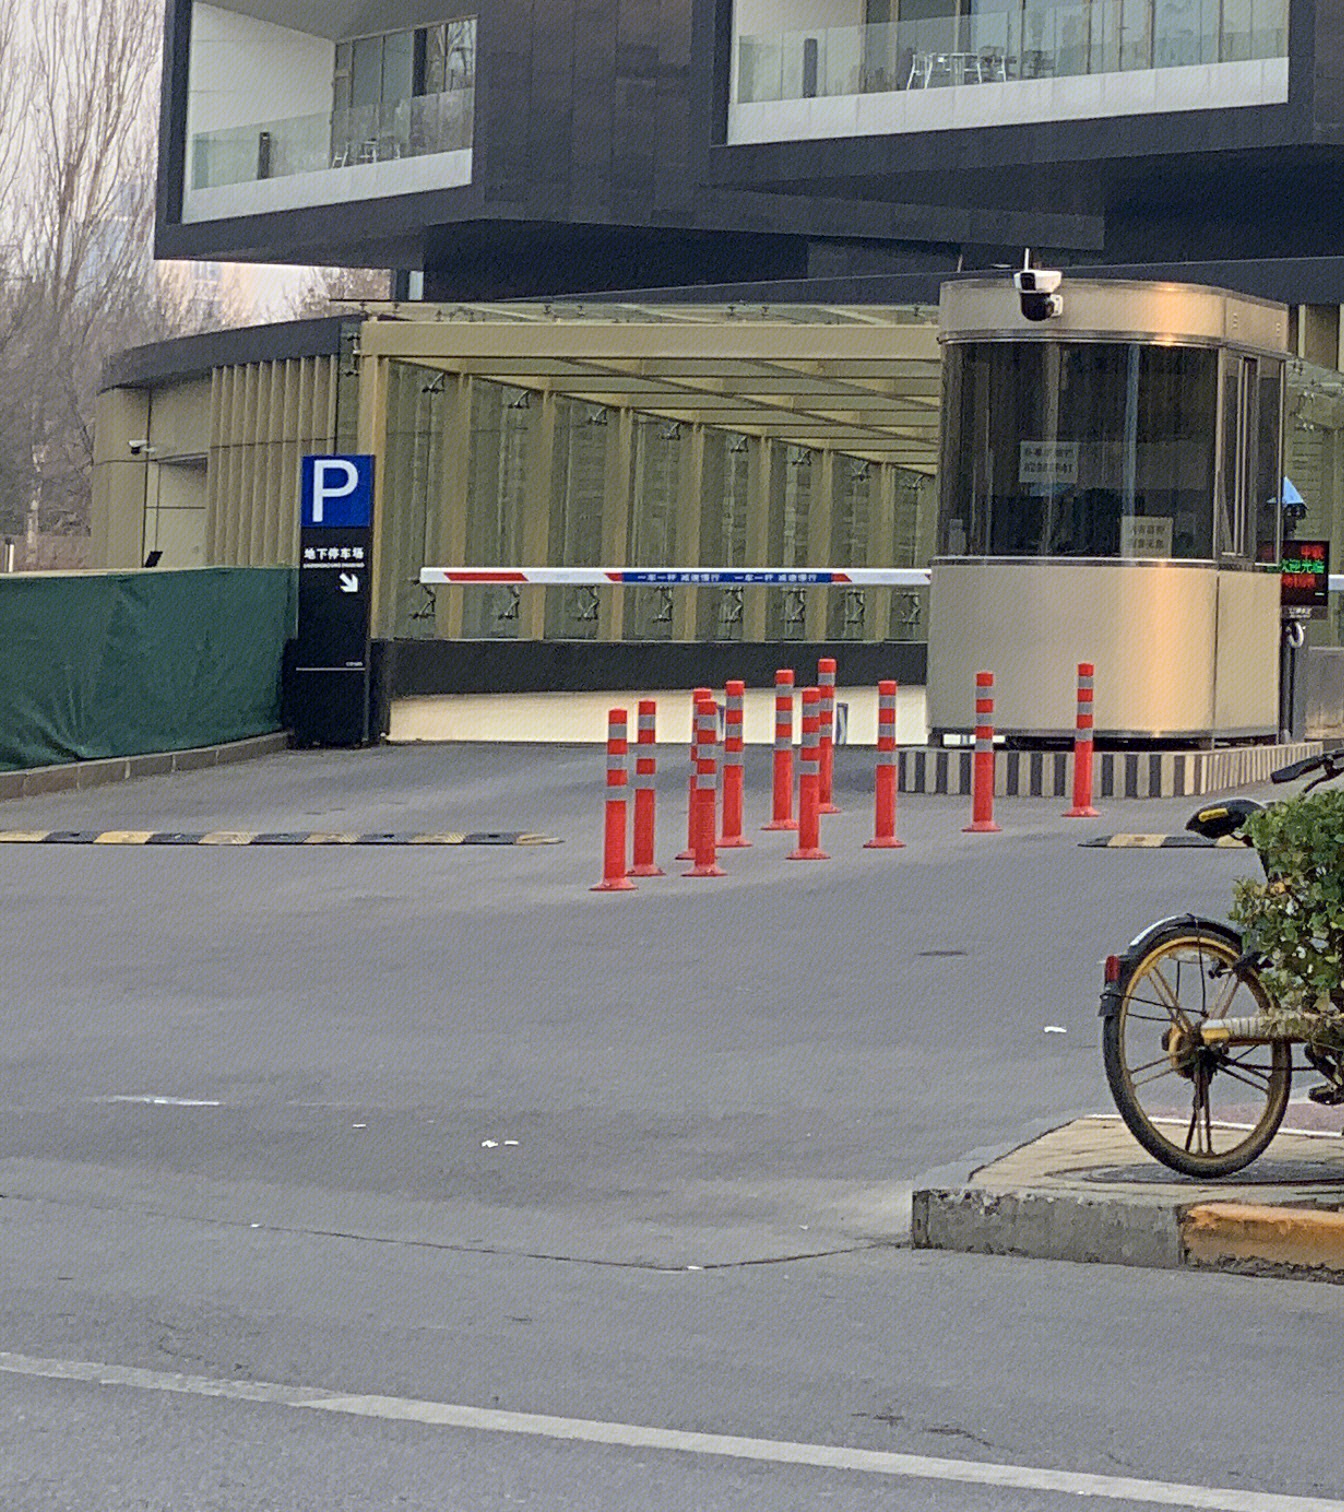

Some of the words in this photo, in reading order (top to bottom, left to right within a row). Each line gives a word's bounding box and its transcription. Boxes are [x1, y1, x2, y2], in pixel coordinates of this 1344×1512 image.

[312, 459, 359, 523] P
[304, 547, 364, 561] 地下停车场
